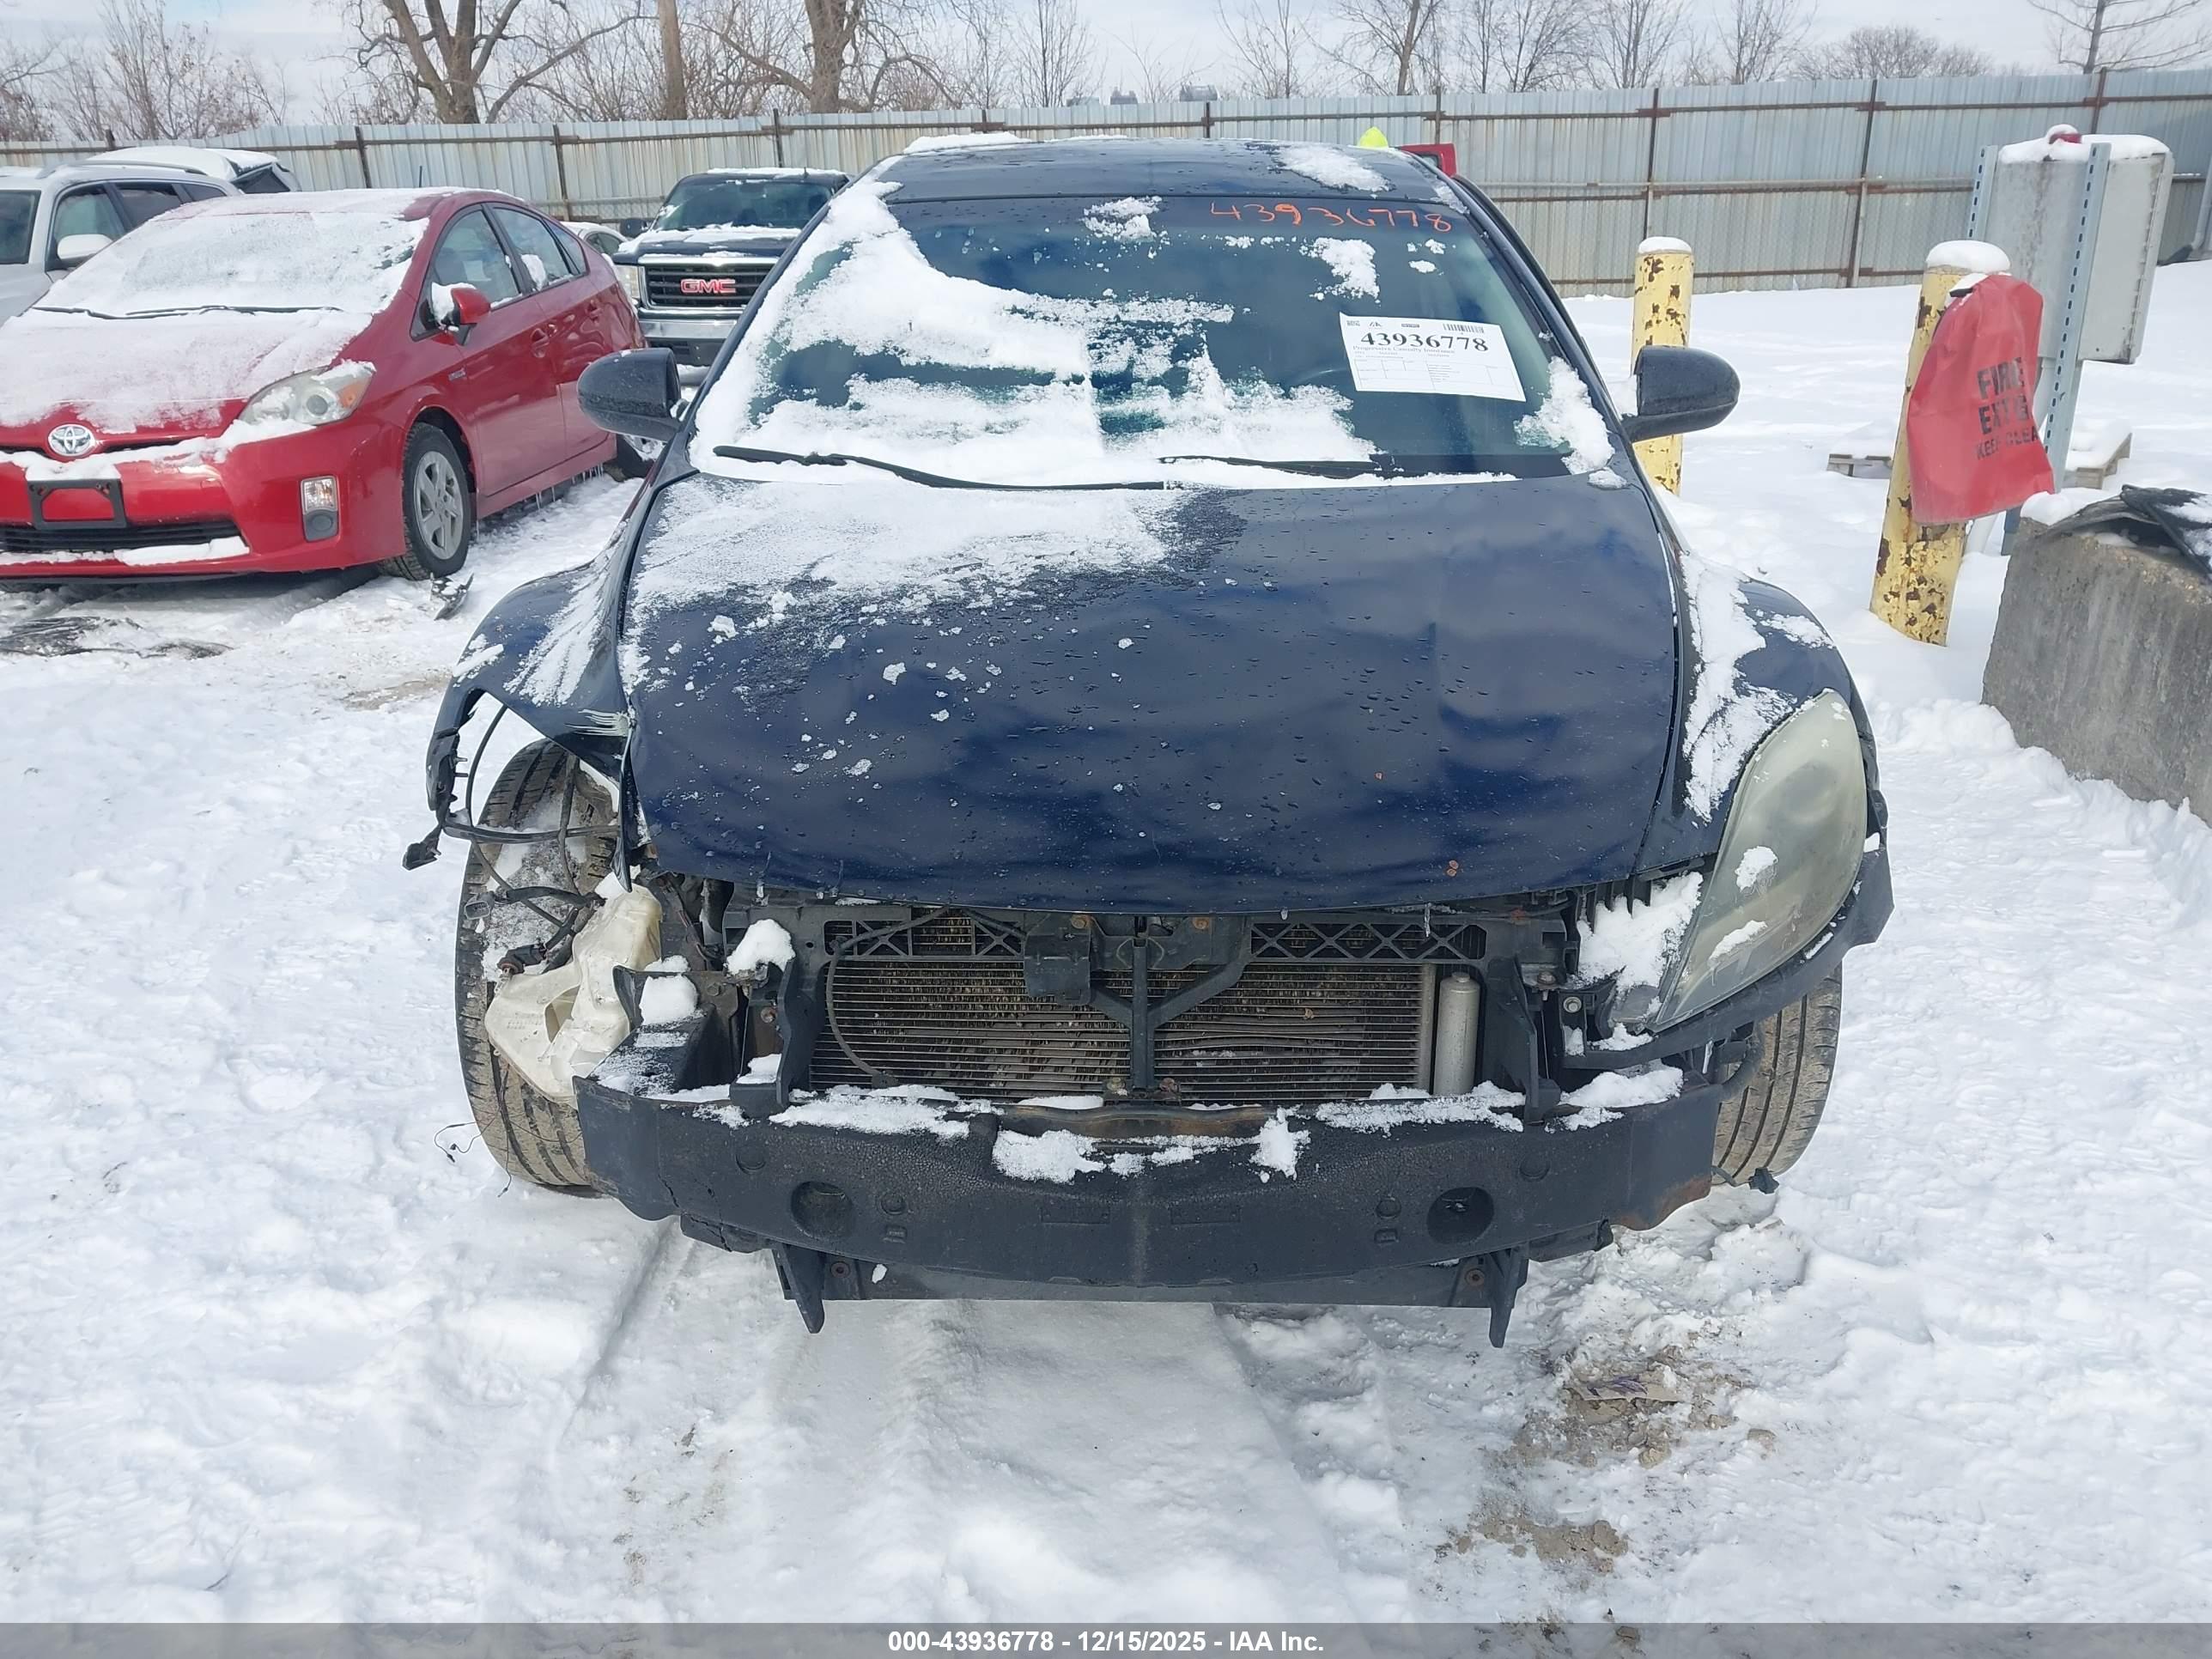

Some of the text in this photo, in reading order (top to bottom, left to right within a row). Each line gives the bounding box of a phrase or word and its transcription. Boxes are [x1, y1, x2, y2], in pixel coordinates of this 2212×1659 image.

[1211, 202, 1452, 234] 43936778
[680, 278, 736, 294] GMC
[1360, 331, 1489, 352] 43936778
